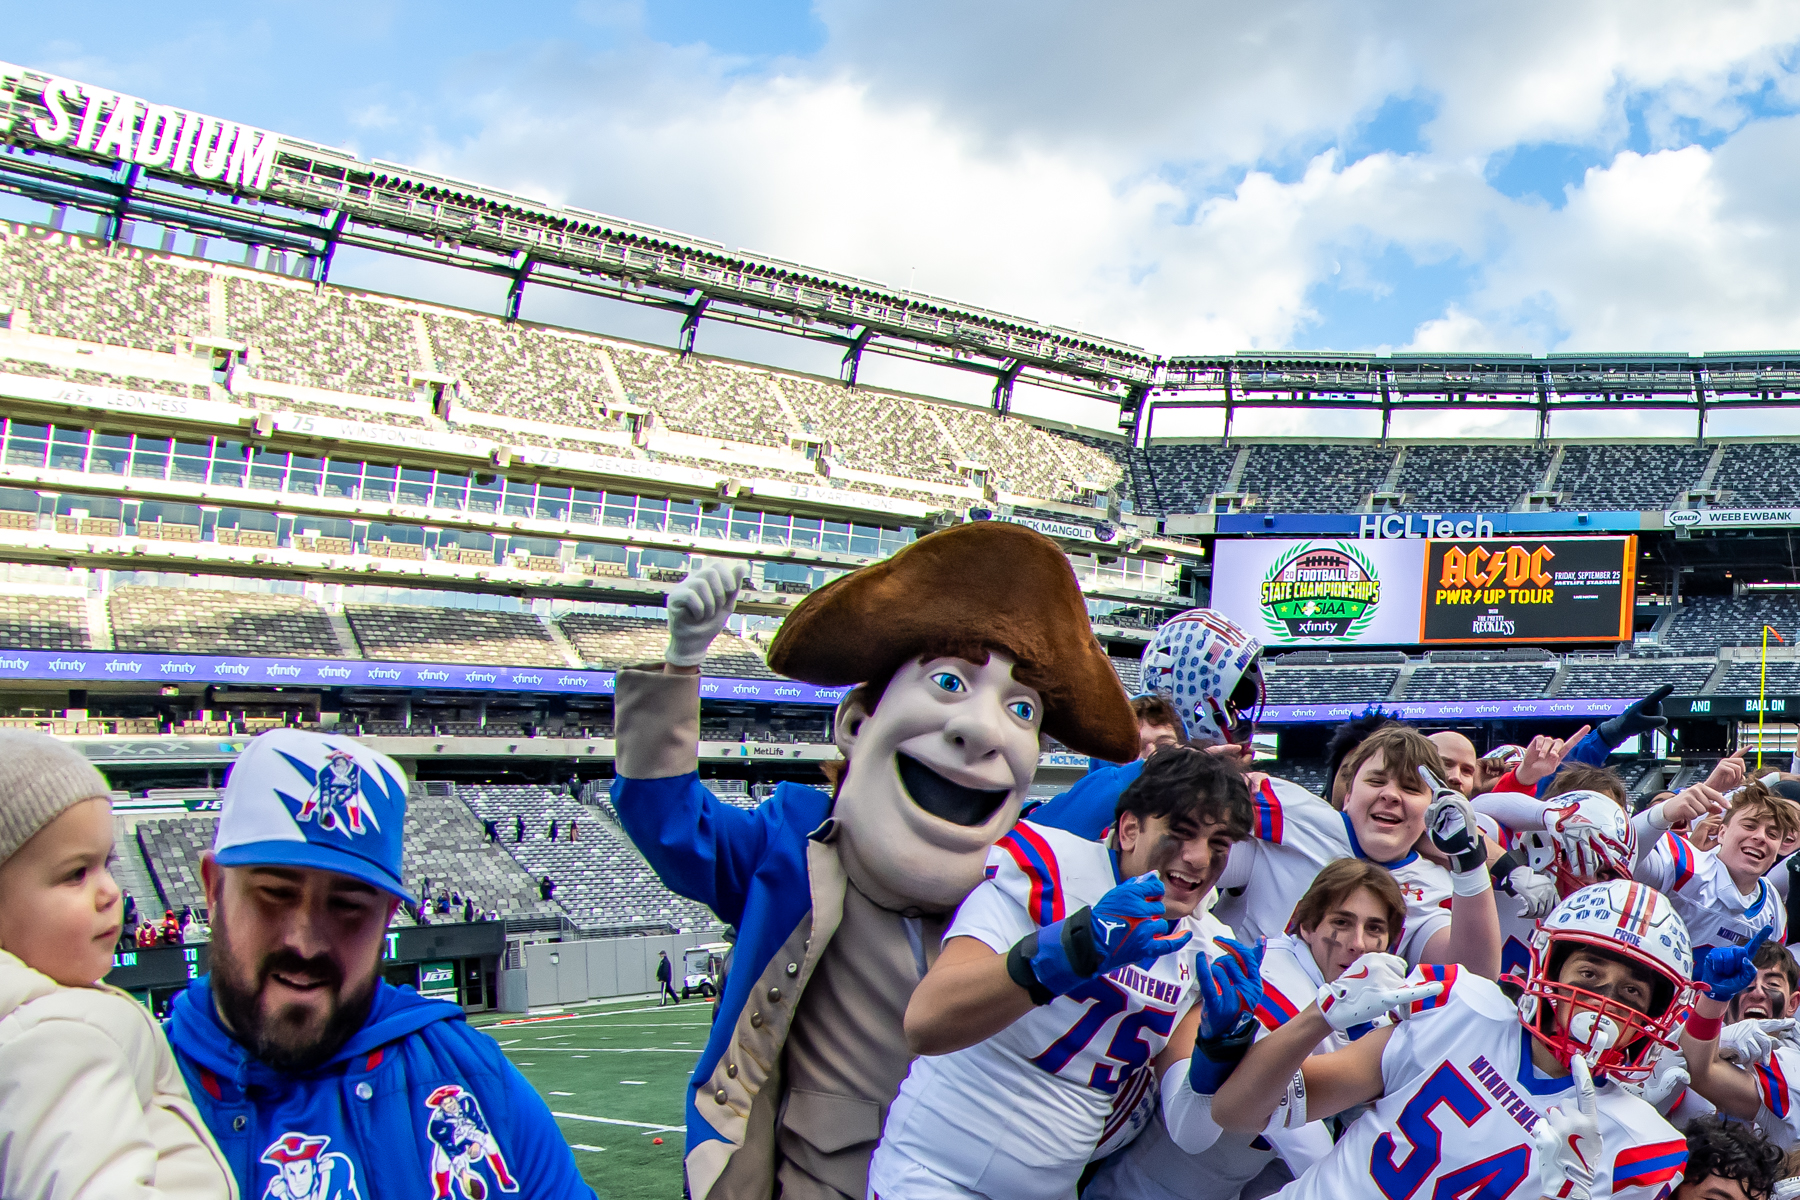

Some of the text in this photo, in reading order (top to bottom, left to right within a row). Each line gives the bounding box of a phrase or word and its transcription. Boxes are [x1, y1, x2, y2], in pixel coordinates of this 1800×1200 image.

[33, 78, 278, 190] STADIUM
[107, 393, 145, 410] LEON
[151, 398, 187, 414] HESS
[292, 415, 436, 447] 75 WINSTON HILL
[539, 449, 561, 465] 73
[790, 484, 809, 499] 93
[1709, 512, 1741, 522] WEEB
[1743, 511, 1792, 521] EWBANK
[1017, 518, 1040, 532] NICK
[1041, 522, 1093, 539] MANGOLD
[1358, 514, 1494, 540] HCLTech
[1284, 568, 1359, 582] 20 FOOTBALL 25
[1554, 571, 1620, 581] FRIDAY, SEPTEMBER 25
[1261, 580, 1380, 604] STATE CHAMPIONSHIPS
[1508, 588, 1554, 604] TOUR
[1298, 620, 1338, 634] xfinity
[1472, 620, 1515, 635] RECKLESS
[0, 656, 589, 688] finity xfinity xfinity xfinity
[814, 688, 842, 700] xfinity
[1475, 703, 1501, 714] xfinity
[1690, 700, 1711, 712] AND
[1771, 699, 1785, 712] ON
[753, 745, 785, 757] MetLife
[1049, 754, 1090, 767] HCLTech
[1613, 927, 1642, 948] PRIDE
[123, 952, 138, 966] ON
[183, 948, 198, 962] TO
[187, 964, 199, 979] 2
[422, 968, 454, 982] JETS
[1108, 965, 1182, 1006] MINUTEMEN
[1031, 975, 1178, 1094] 75
[1467, 1054, 1542, 1138] MINUTEME
